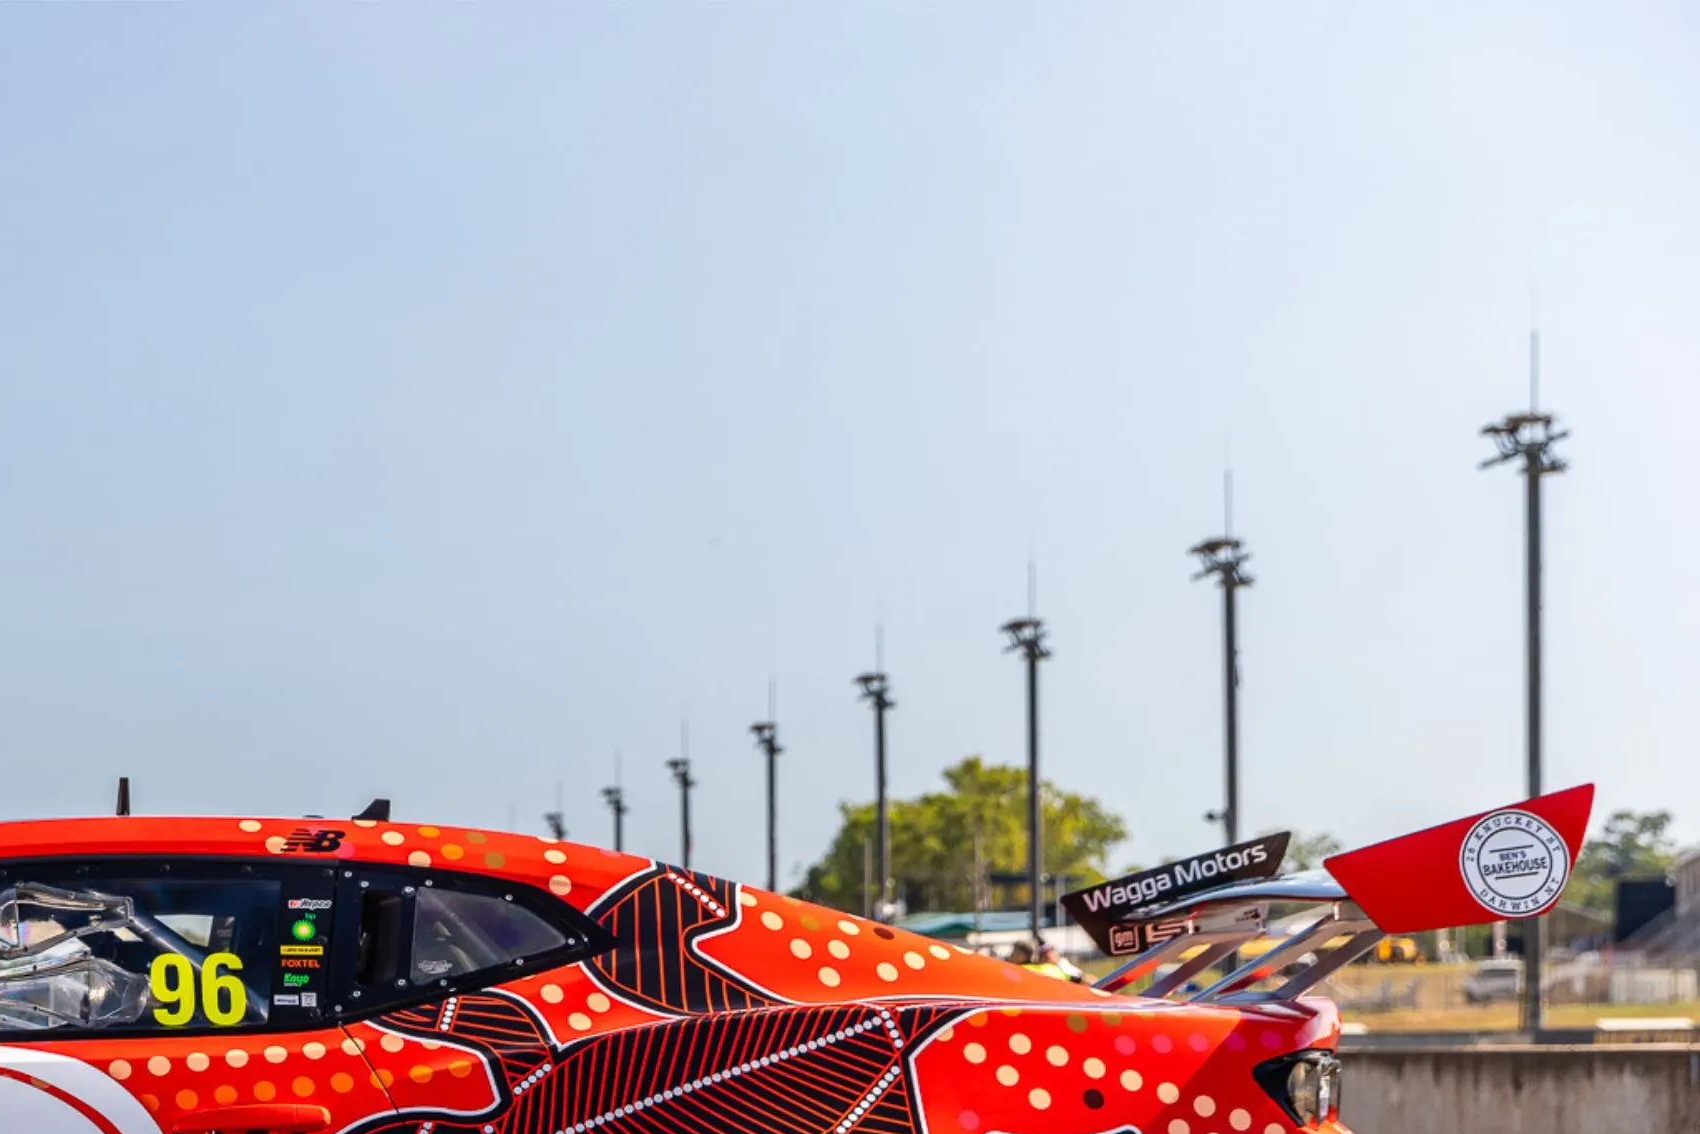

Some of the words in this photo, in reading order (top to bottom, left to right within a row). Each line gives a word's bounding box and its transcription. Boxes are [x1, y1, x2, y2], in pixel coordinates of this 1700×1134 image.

[1499, 850, 1527, 861] BEN'S
[1483, 857, 1548, 876] BAKEHOUSE
[1082, 872, 1172, 912] Wagga
[1174, 844, 1268, 886] Motors
[1480, 888, 1540, 911] DARWIN
[281, 959, 320, 968] FOXTEL
[151, 952, 247, 1027] 96
